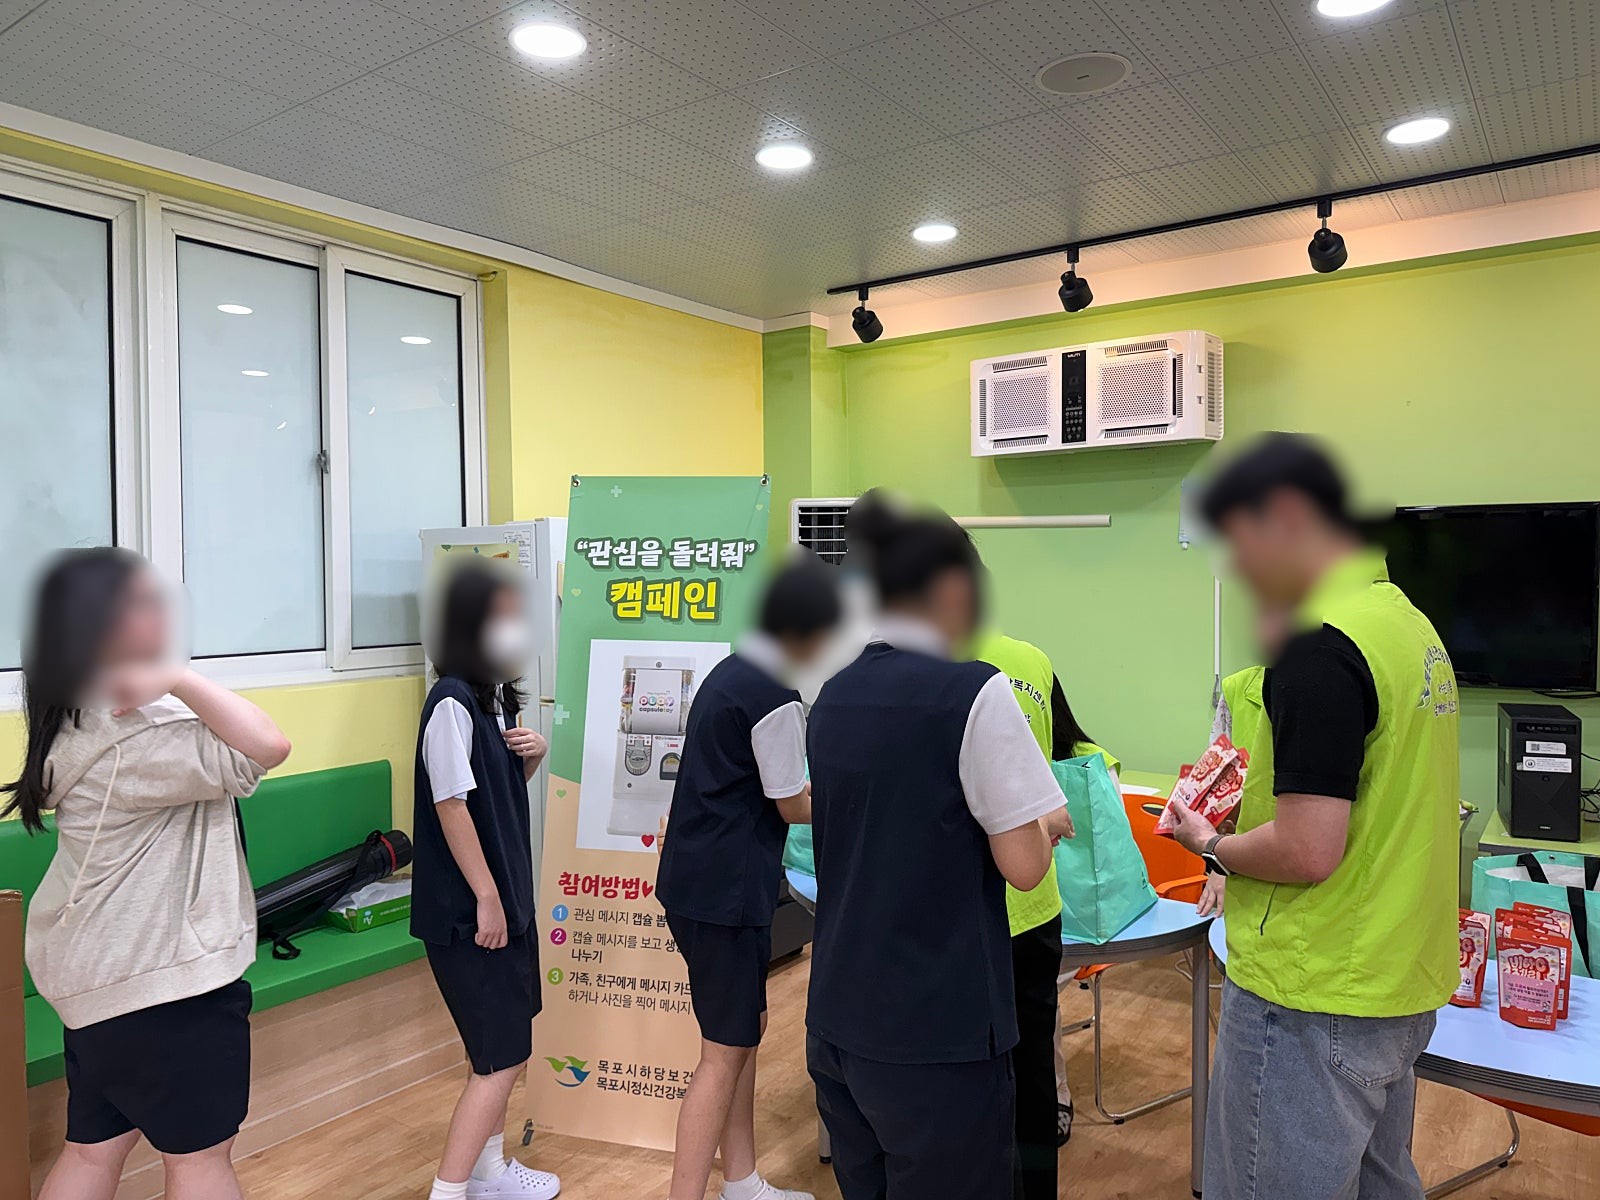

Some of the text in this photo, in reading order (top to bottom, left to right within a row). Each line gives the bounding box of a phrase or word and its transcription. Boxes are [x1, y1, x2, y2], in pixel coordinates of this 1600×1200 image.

[610, 580, 718, 620] 캠페인
[558, 871, 640, 900] 참여방법
[574, 908, 595, 922] 관심
[598, 909, 629, 925] 메시지
[632, 912, 653, 926] 캡슐
[572, 931, 593, 944] 캡슐
[597, 932, 638, 948] 메시지를
[641, 937, 662, 950] 보고
[664, 939, 681, 952] 생
[571, 950, 603, 963] 나누기
[569, 972, 592, 987] 가족,
[596, 973, 637, 990] 친구에게
[640, 978, 671, 994] 메시지
[568, 990, 599, 1004] 하거나
[601, 992, 632, 1008] 사진을
[636, 996, 656, 1011] 찍어
